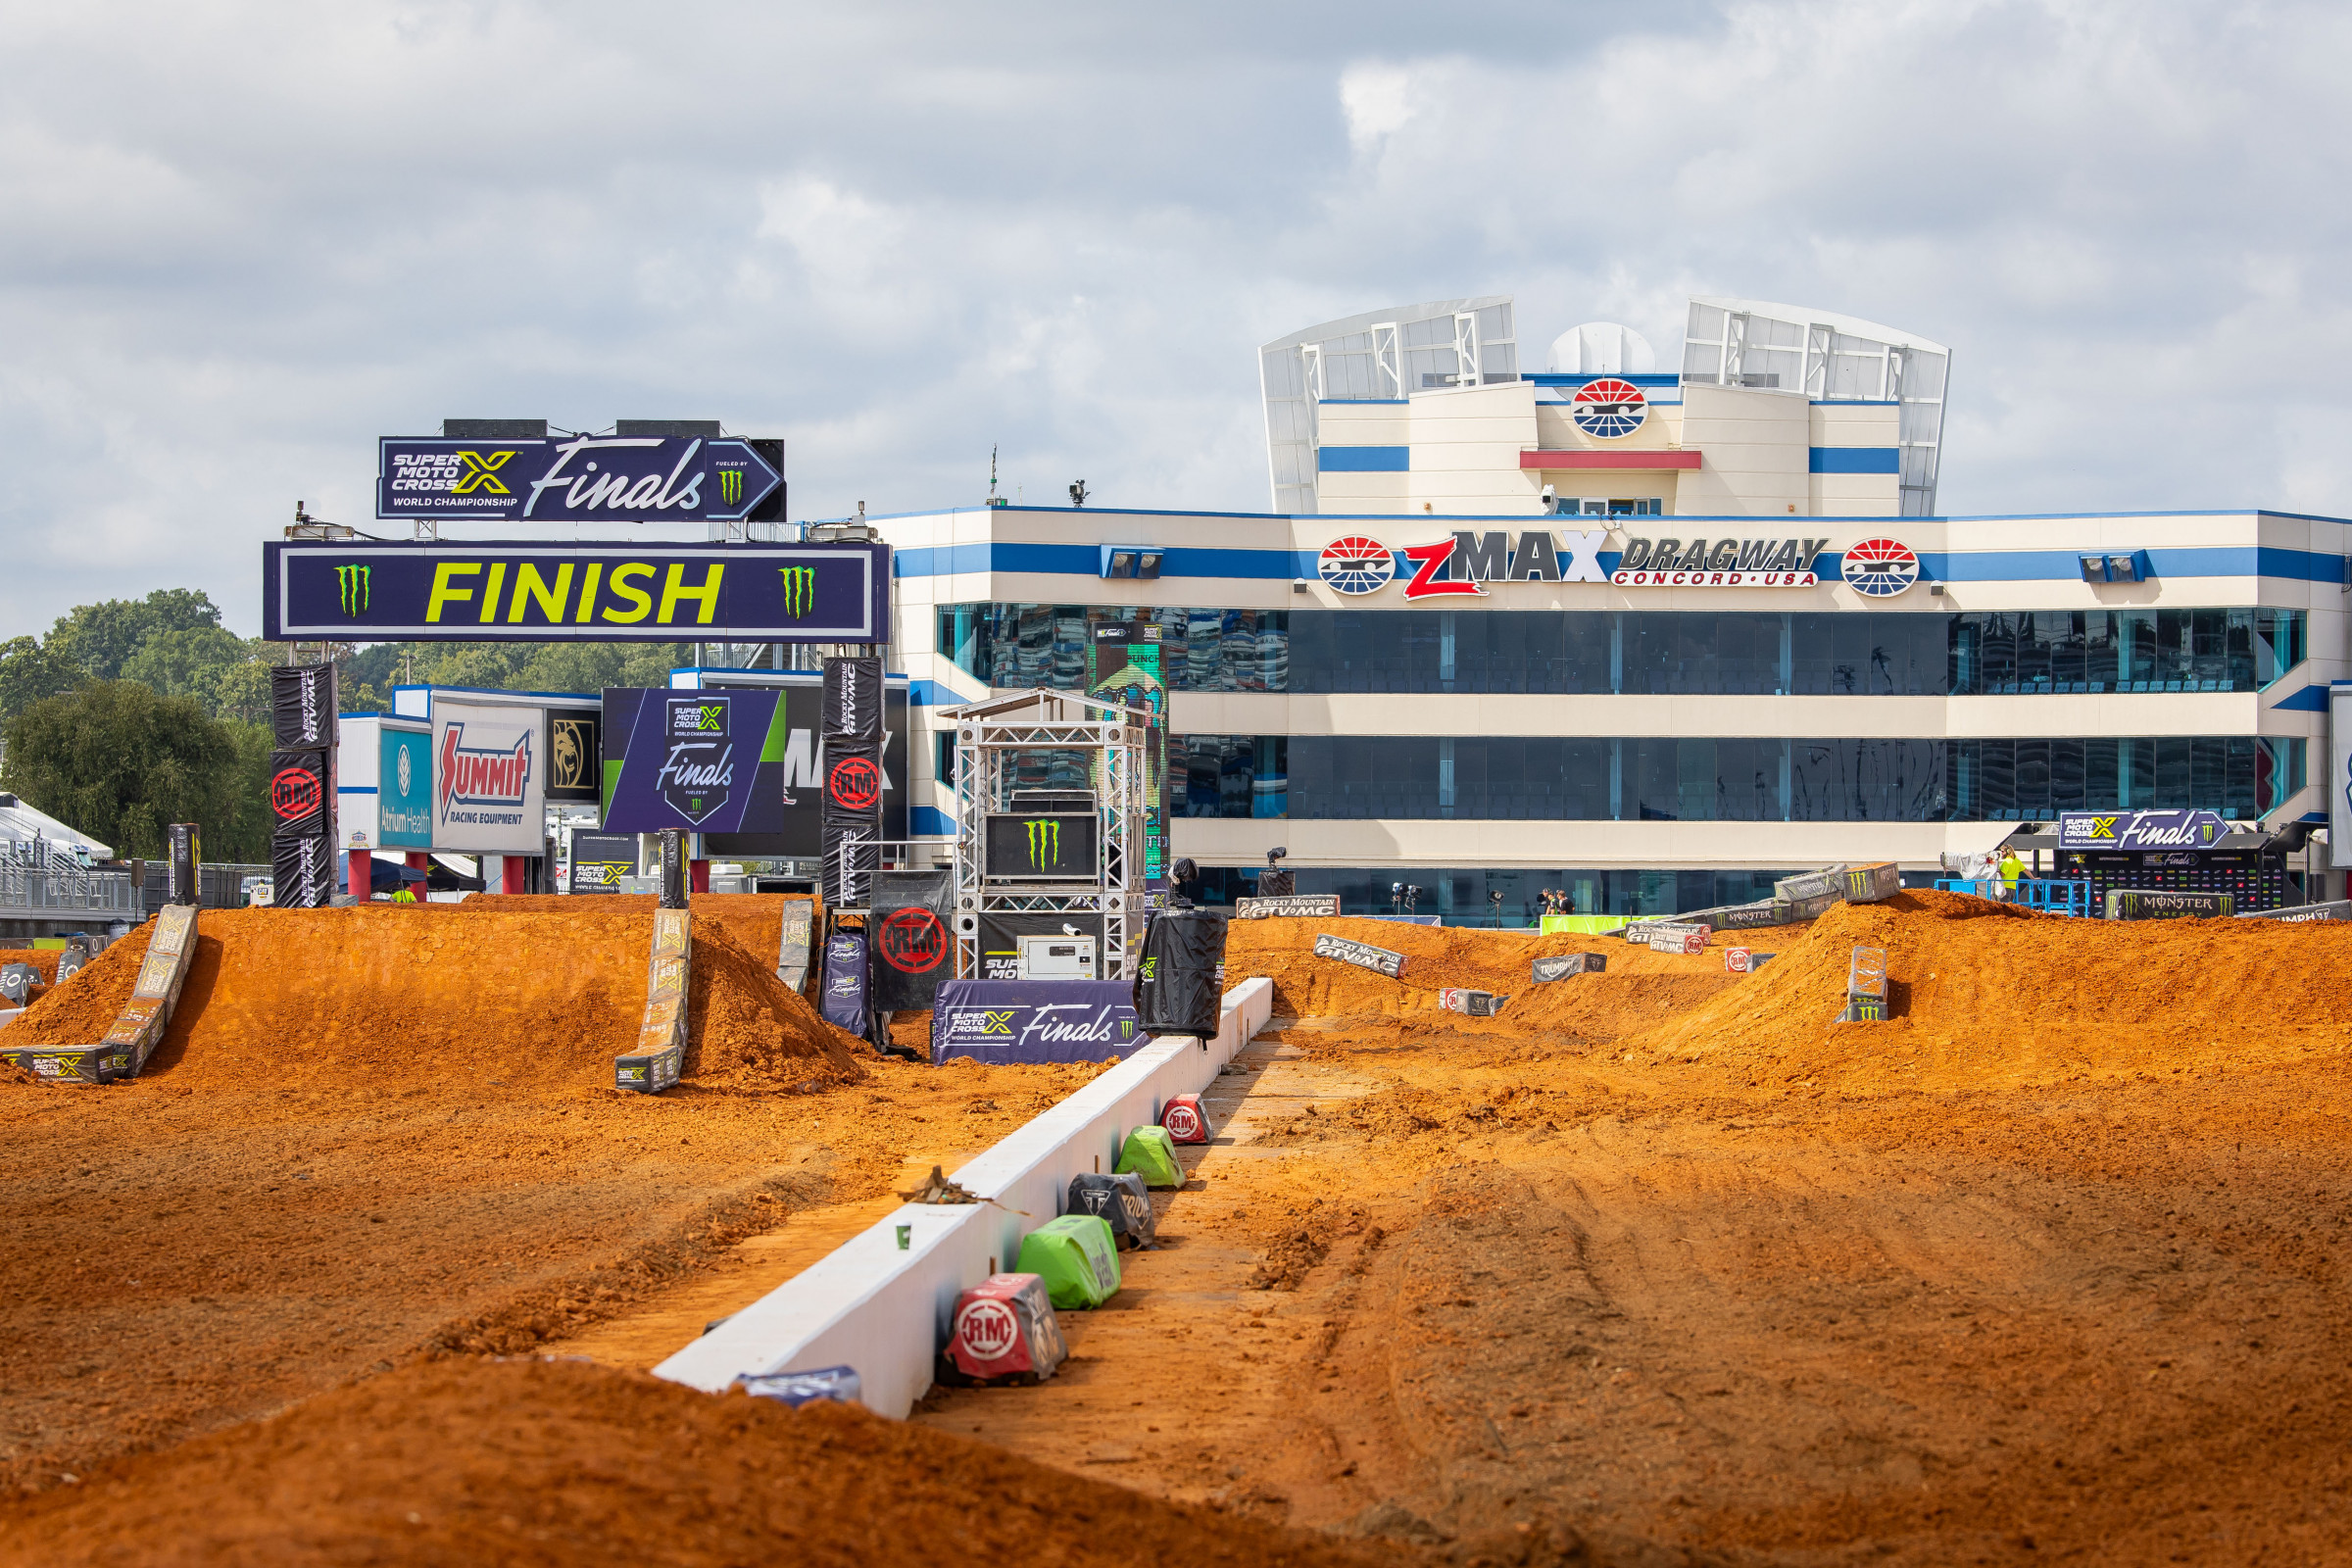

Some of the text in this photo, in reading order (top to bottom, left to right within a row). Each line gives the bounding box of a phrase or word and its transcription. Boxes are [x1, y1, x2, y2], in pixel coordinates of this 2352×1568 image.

[392, 454, 463, 466] SUPER
[396, 466, 459, 478] MOTO
[523, 436, 705, 517] Finals
[391, 479, 460, 491] CROSS
[393, 498, 518, 507] WORLD CHAMPIONSHIP
[1617, 538, 1832, 570] DRAGWAY
[1614, 571, 1815, 586] CONCORD USA
[425, 563, 724, 624] FINISH
[300, 670, 309, 708] MOUNTAIN
[656, 741, 734, 791] Finals
[381, 806, 431, 835] Atrium Health
[450, 811, 523, 825] RACING EQUIPMENT
[2119, 809, 2197, 849] Finals
[2143, 895, 2213, 910] MONSTER
[1729, 908, 1772, 921] MONSTER
[891, 925, 936, 955] RM
[1331, 939, 1357, 952] ROCKY
[1018, 1004, 1113, 1046] Finals
[1172, 1115, 1192, 1128] RM
[968, 1318, 1005, 1341] RM
